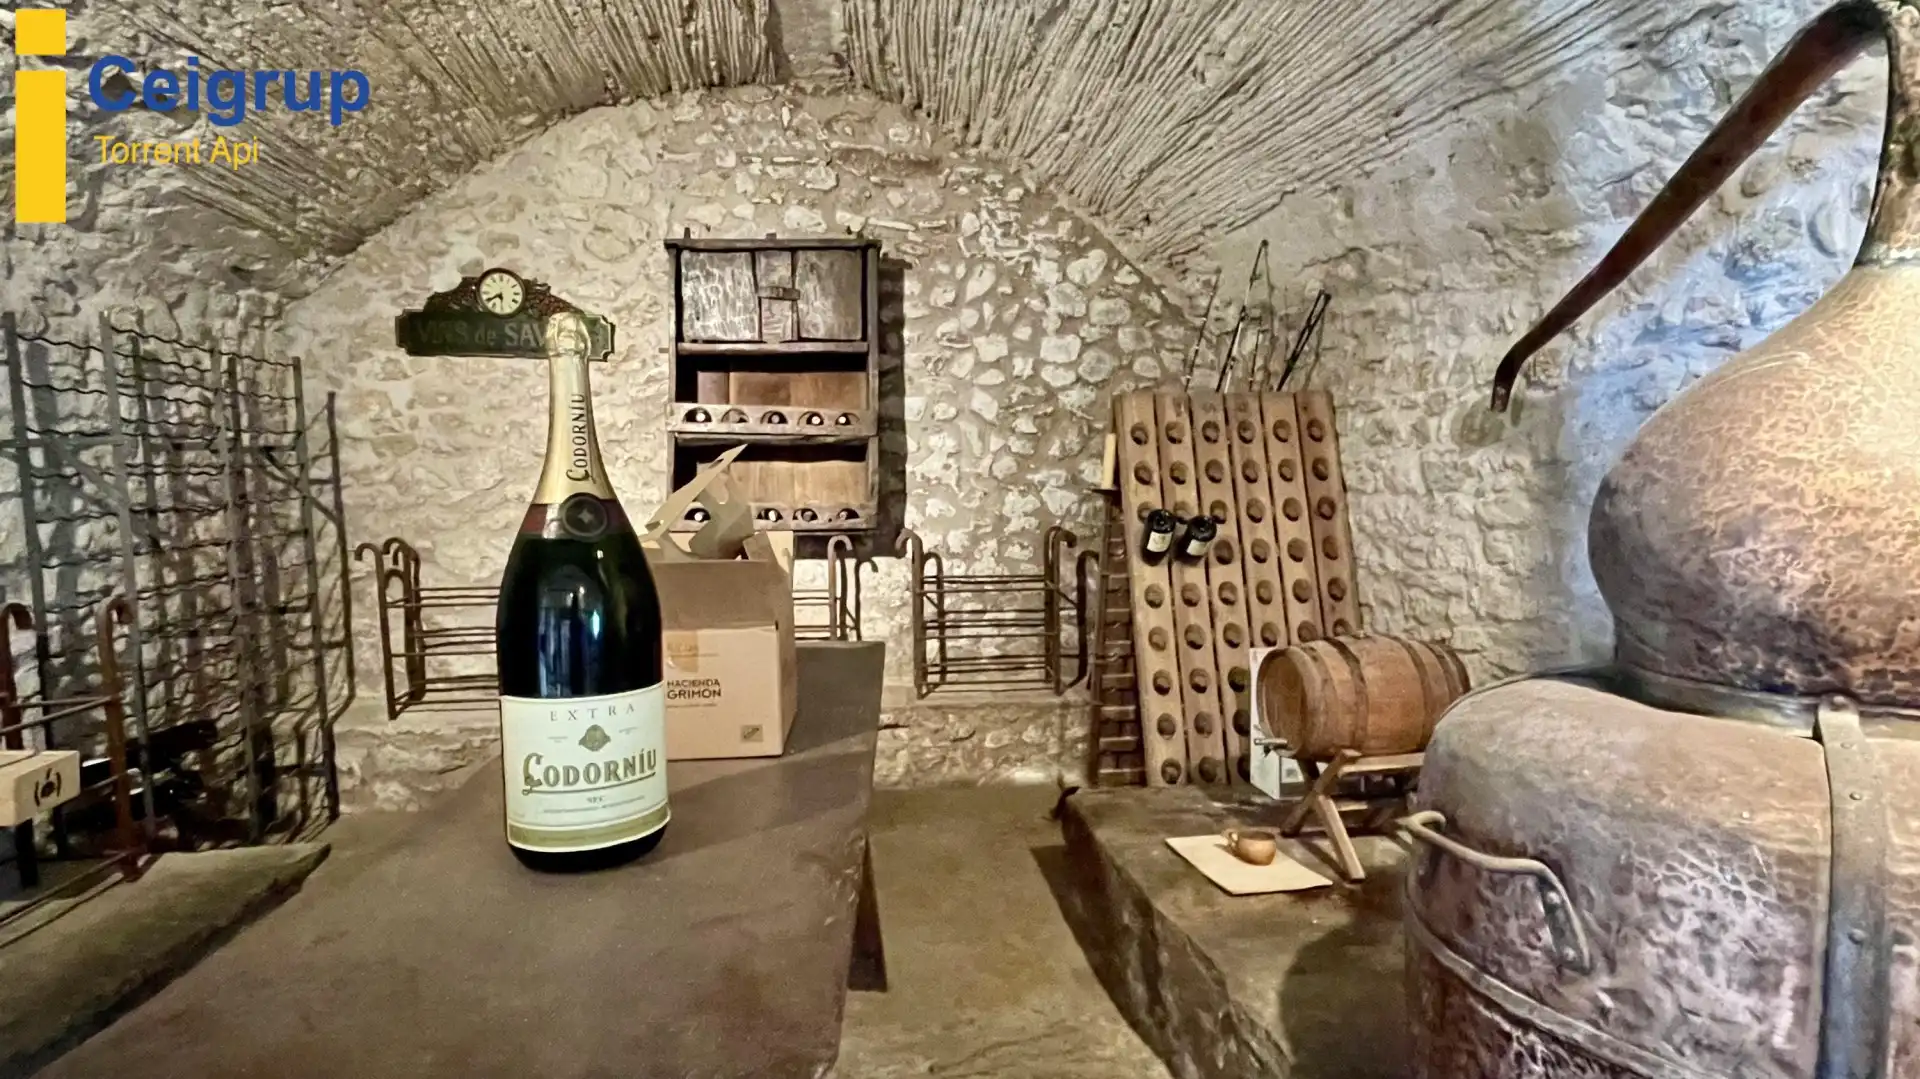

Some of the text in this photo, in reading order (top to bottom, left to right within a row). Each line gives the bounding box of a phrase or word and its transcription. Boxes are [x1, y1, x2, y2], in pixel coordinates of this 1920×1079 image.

[474, 321, 497, 346] de
[503, 321, 548, 348] SAV
[666, 678, 721, 689] HACIENDA
[550, 703, 635, 722] EXTRA
